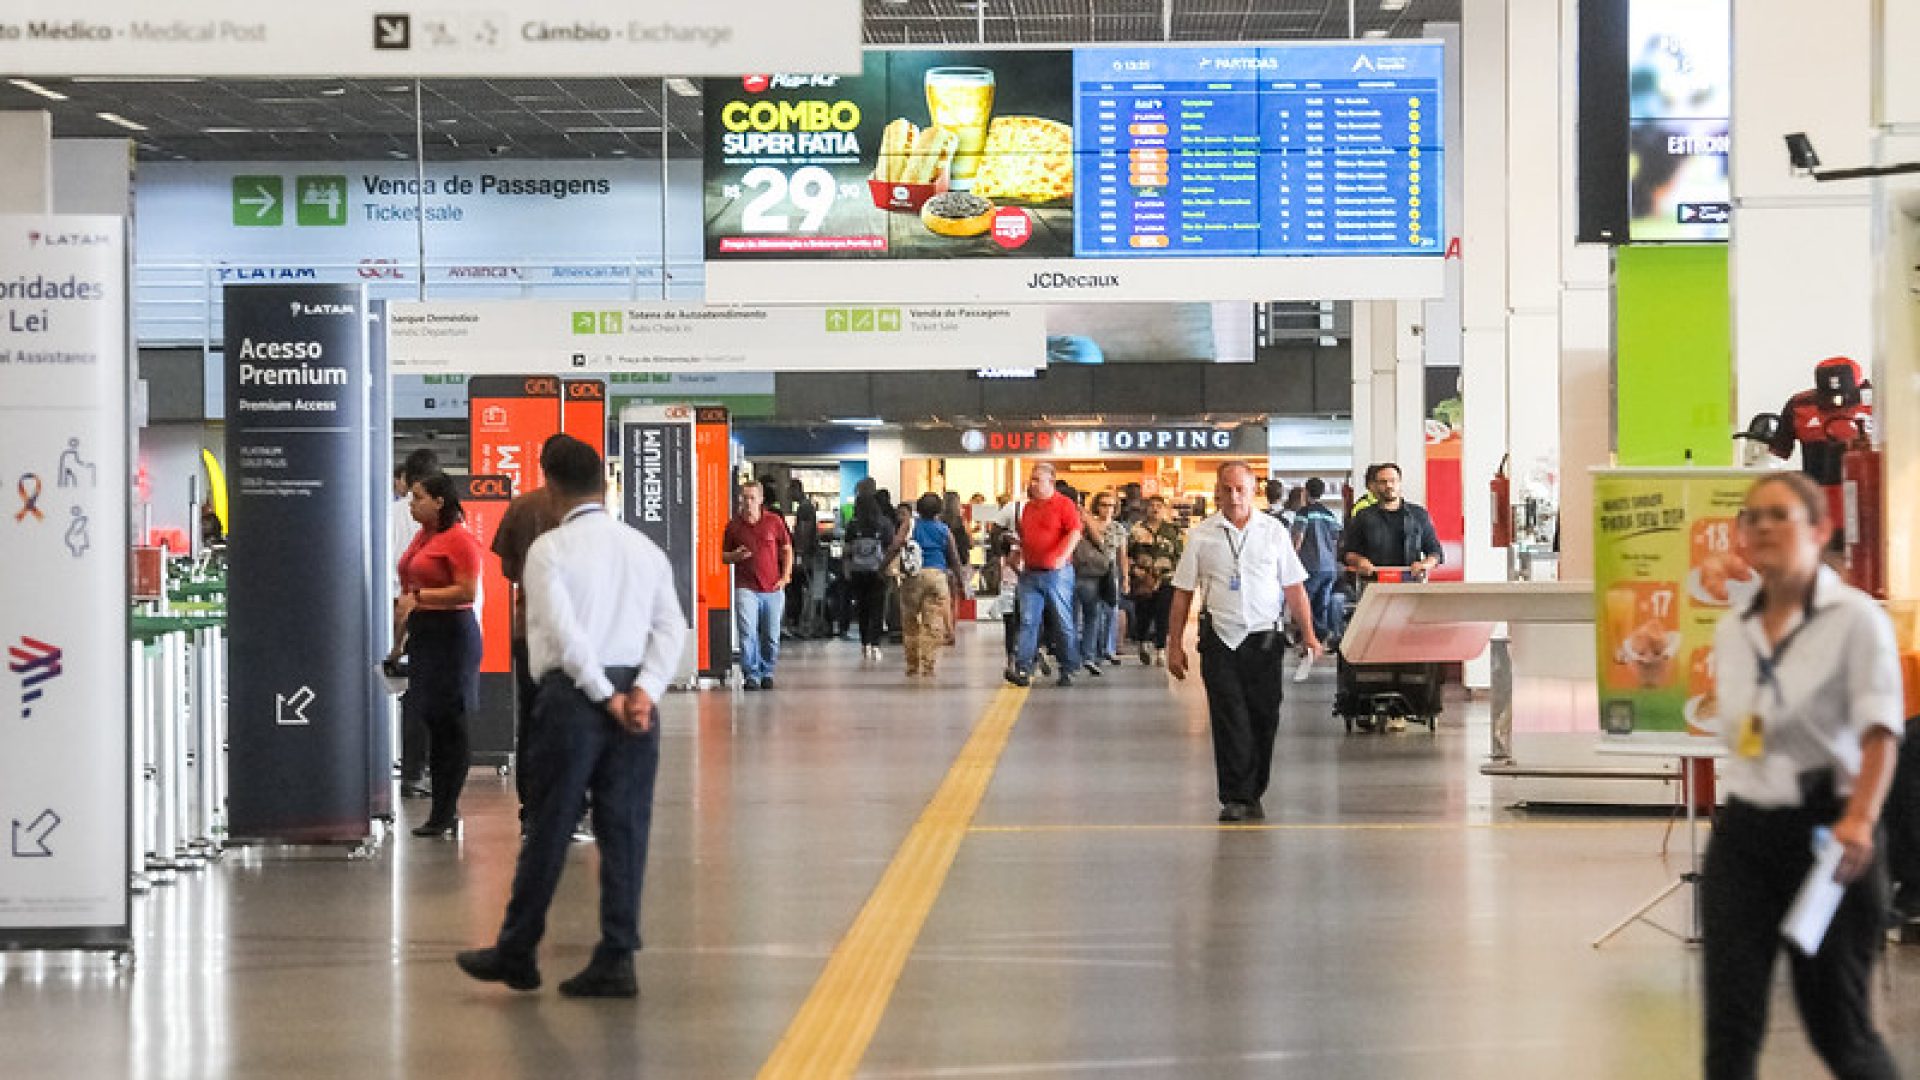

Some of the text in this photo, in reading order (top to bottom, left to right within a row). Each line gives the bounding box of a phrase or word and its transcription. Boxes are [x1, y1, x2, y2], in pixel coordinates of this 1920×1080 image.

[28, 20, 112, 41] Médico
[130, 20, 216, 42] Medical
[221, 20, 268, 42] Post
[521, 20, 734, 48] Câmbio Exchange
[722, 100, 861, 132] COMBO
[722, 132, 860, 154] SUPER FATIA
[363, 174, 611, 200] Venda de Passagens
[742, 166, 836, 232] 29
[364, 203, 464, 222] Ticket sale
[45, 233, 109, 246] LATAM
[1027, 270, 1120, 289] JCDecaux
[305, 304, 354, 314] LATAM
[9, 308, 49, 333] Lei
[17, 349, 97, 364] Assistance
[239, 338, 322, 359] Acesso
[239, 363, 349, 385] Premium
[525, 377, 558, 395] GOL
[569, 383, 601, 398] GOL
[239, 397, 337, 412] Premium Access
[642, 429, 662, 522] PREMIUM
[470, 479, 510, 496] GOL
